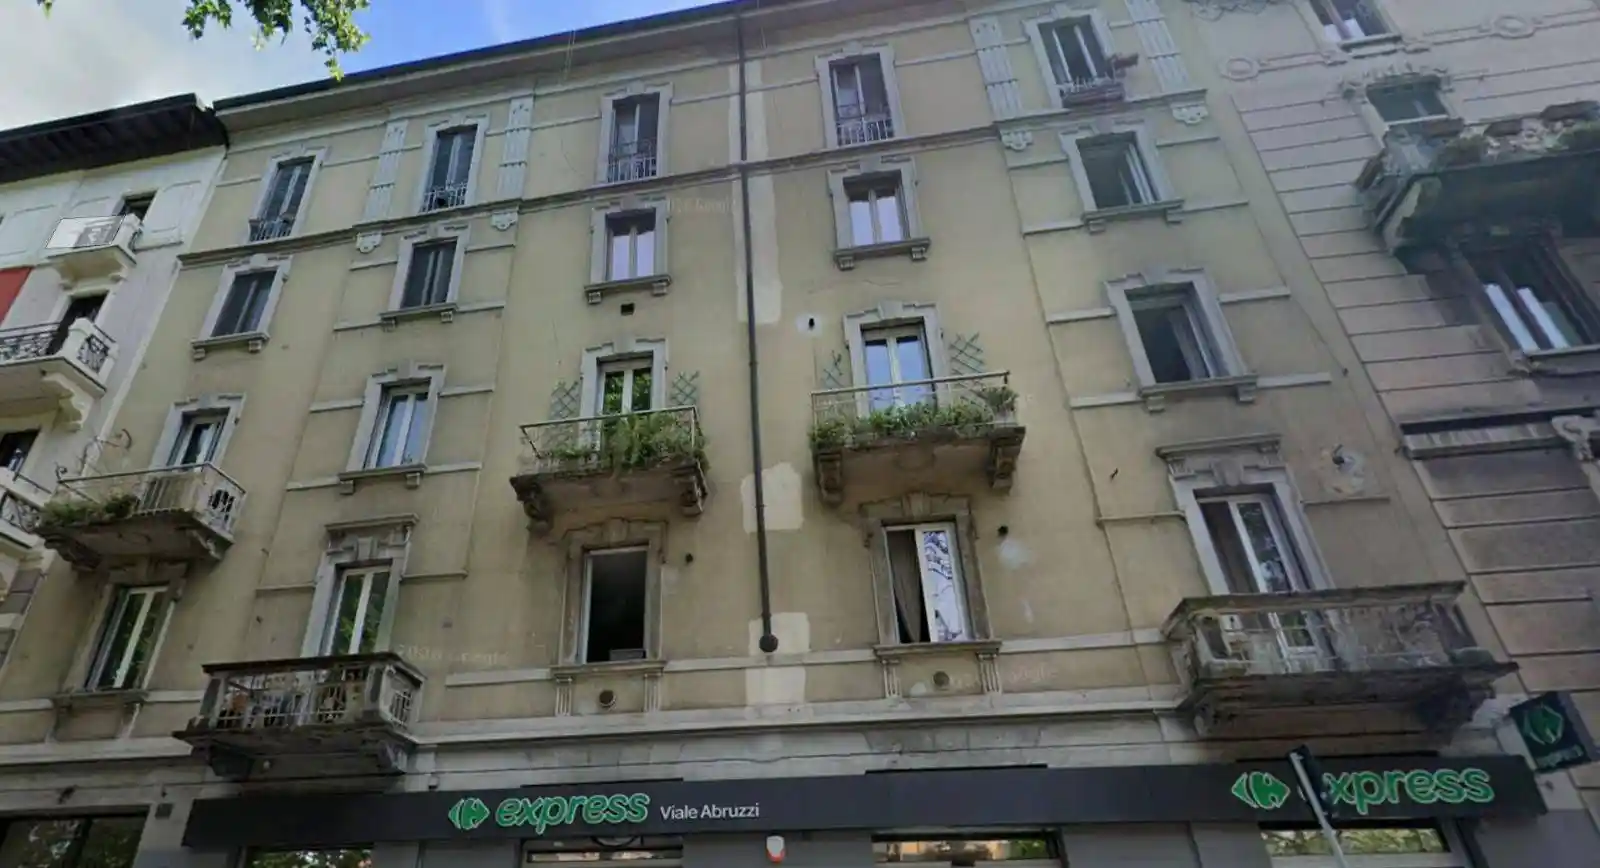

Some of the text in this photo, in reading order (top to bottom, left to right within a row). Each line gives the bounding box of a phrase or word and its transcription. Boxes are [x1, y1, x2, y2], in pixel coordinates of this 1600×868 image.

[495, 793, 760, 834] express Viale Abruzzi
[1297, 768, 1494, 815] xpress
